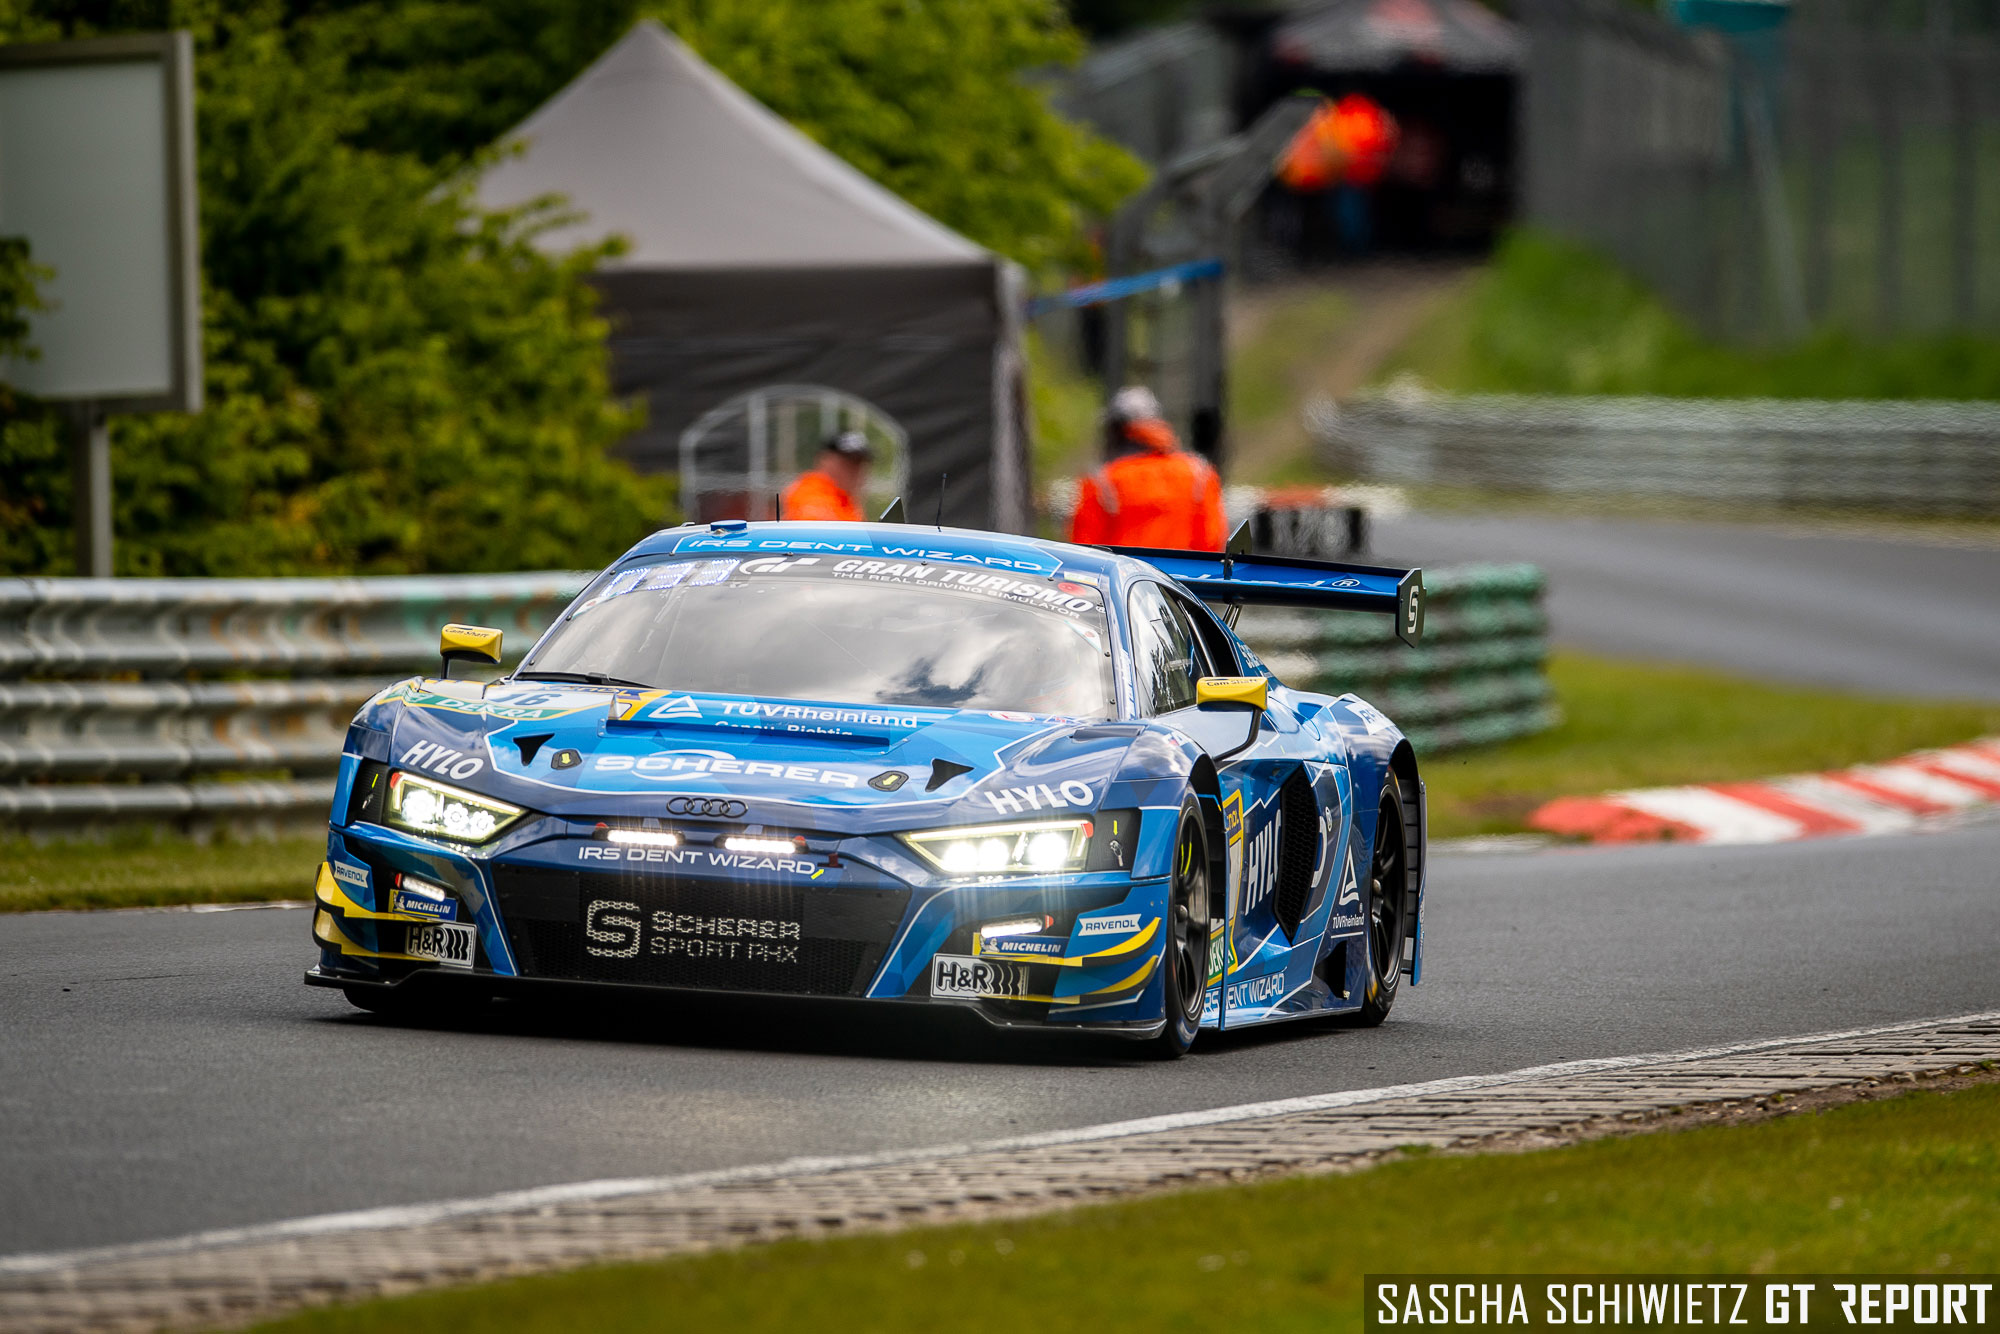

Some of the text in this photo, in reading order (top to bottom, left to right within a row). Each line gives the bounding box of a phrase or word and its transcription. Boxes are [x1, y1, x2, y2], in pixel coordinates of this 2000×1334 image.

[690, 540, 1043, 571] IRS DENT WIZARD
[833, 559, 1094, 612] GRAN TURISMO
[867, 574, 910, 584] REAL
[916, 579, 982, 595] DRIVING
[987, 589, 1080, 618] SIMULATOR
[399, 739, 484, 780] HYLO
[594, 756, 859, 788] SCHERER
[984, 779, 1094, 815] HYLO
[336, 866, 365, 883] RAVENOL
[578, 846, 816, 876] IRS DENT WIZARD
[406, 900, 451, 914] MICHELIN
[652, 911, 800, 940] SCHERER
[1085, 920, 1136, 933] RAVENOL
[408, 925, 447, 958] H&R
[650, 936, 799, 963] SPORT PHX
[1001, 942, 1061, 953] MICHELIN
[937, 963, 991, 993] H&R
[1248, 972, 1285, 1003] WIZARD
